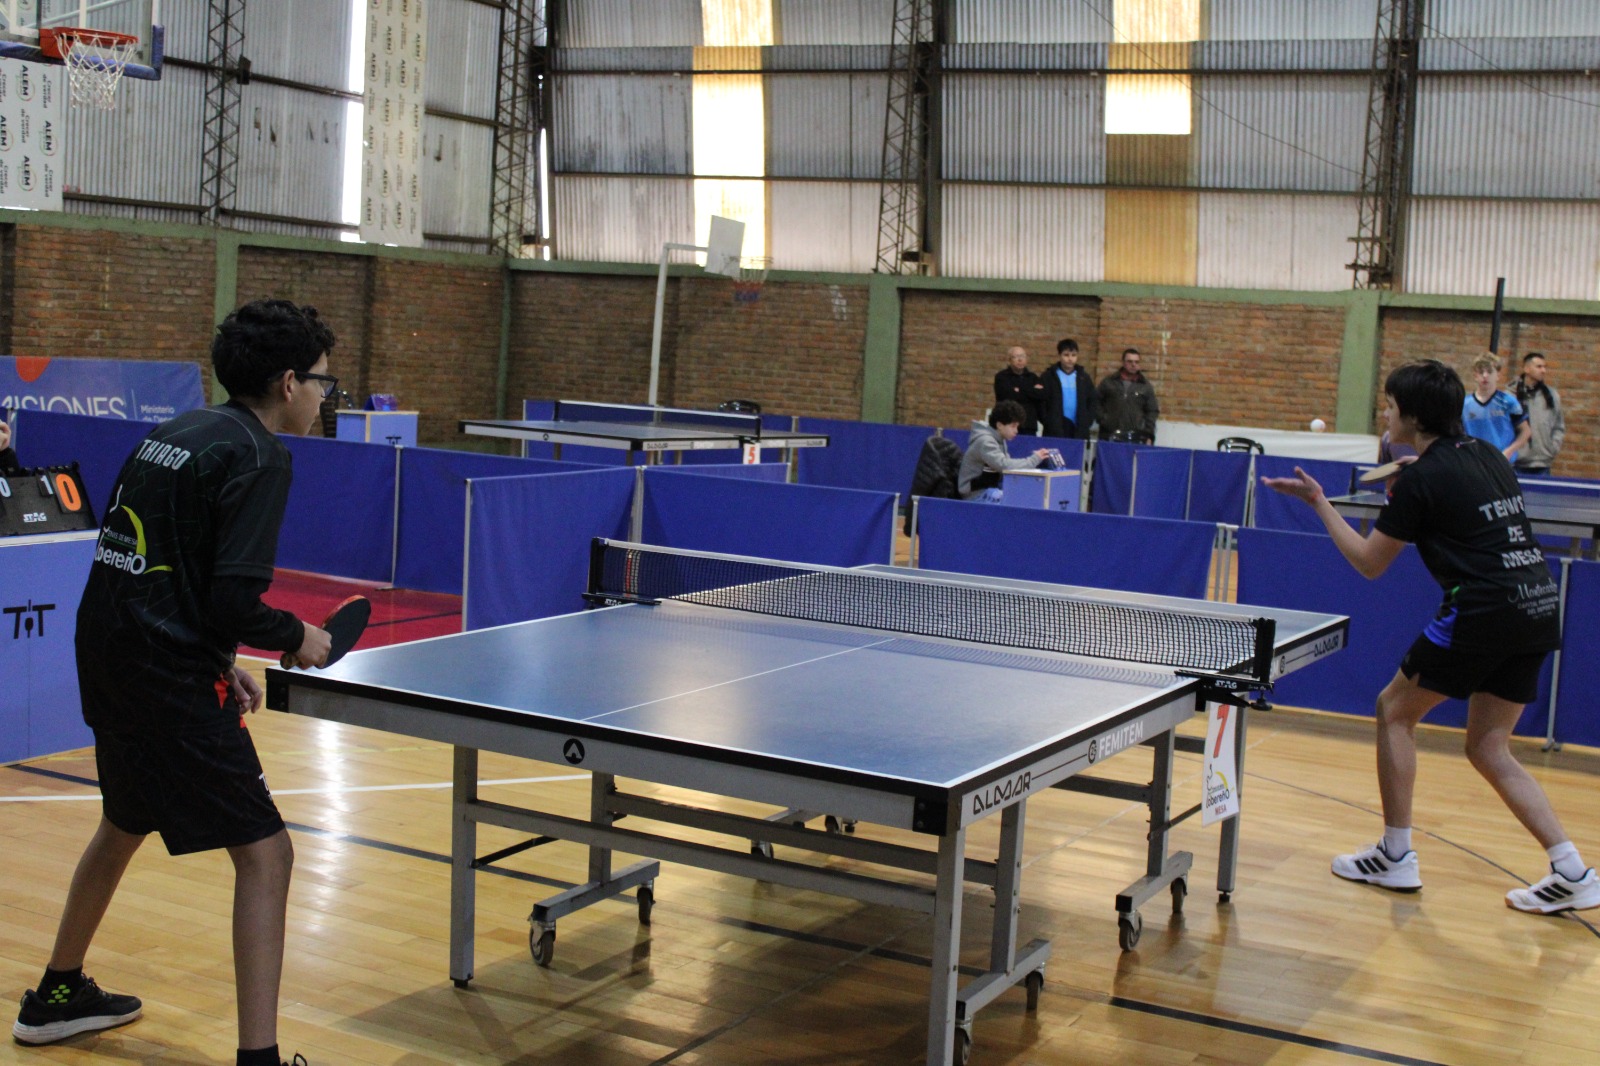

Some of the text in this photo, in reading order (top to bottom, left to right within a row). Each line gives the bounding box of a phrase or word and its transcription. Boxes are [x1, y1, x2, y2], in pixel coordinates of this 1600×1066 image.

[135, 439, 191, 471] THIAGO
[748, 446, 756, 465] 5
[41, 475, 54, 495] 1
[23, 512, 47, 523] STAG
[1507, 525, 1526, 543] DE
[1215, 679, 1238, 690] STAG
[1099, 721, 1144, 759] FEMITEM
[1213, 704, 1230, 759] 7
[973, 771, 1031, 815] ALMAR
[1215, 804, 1227, 816] MESA
